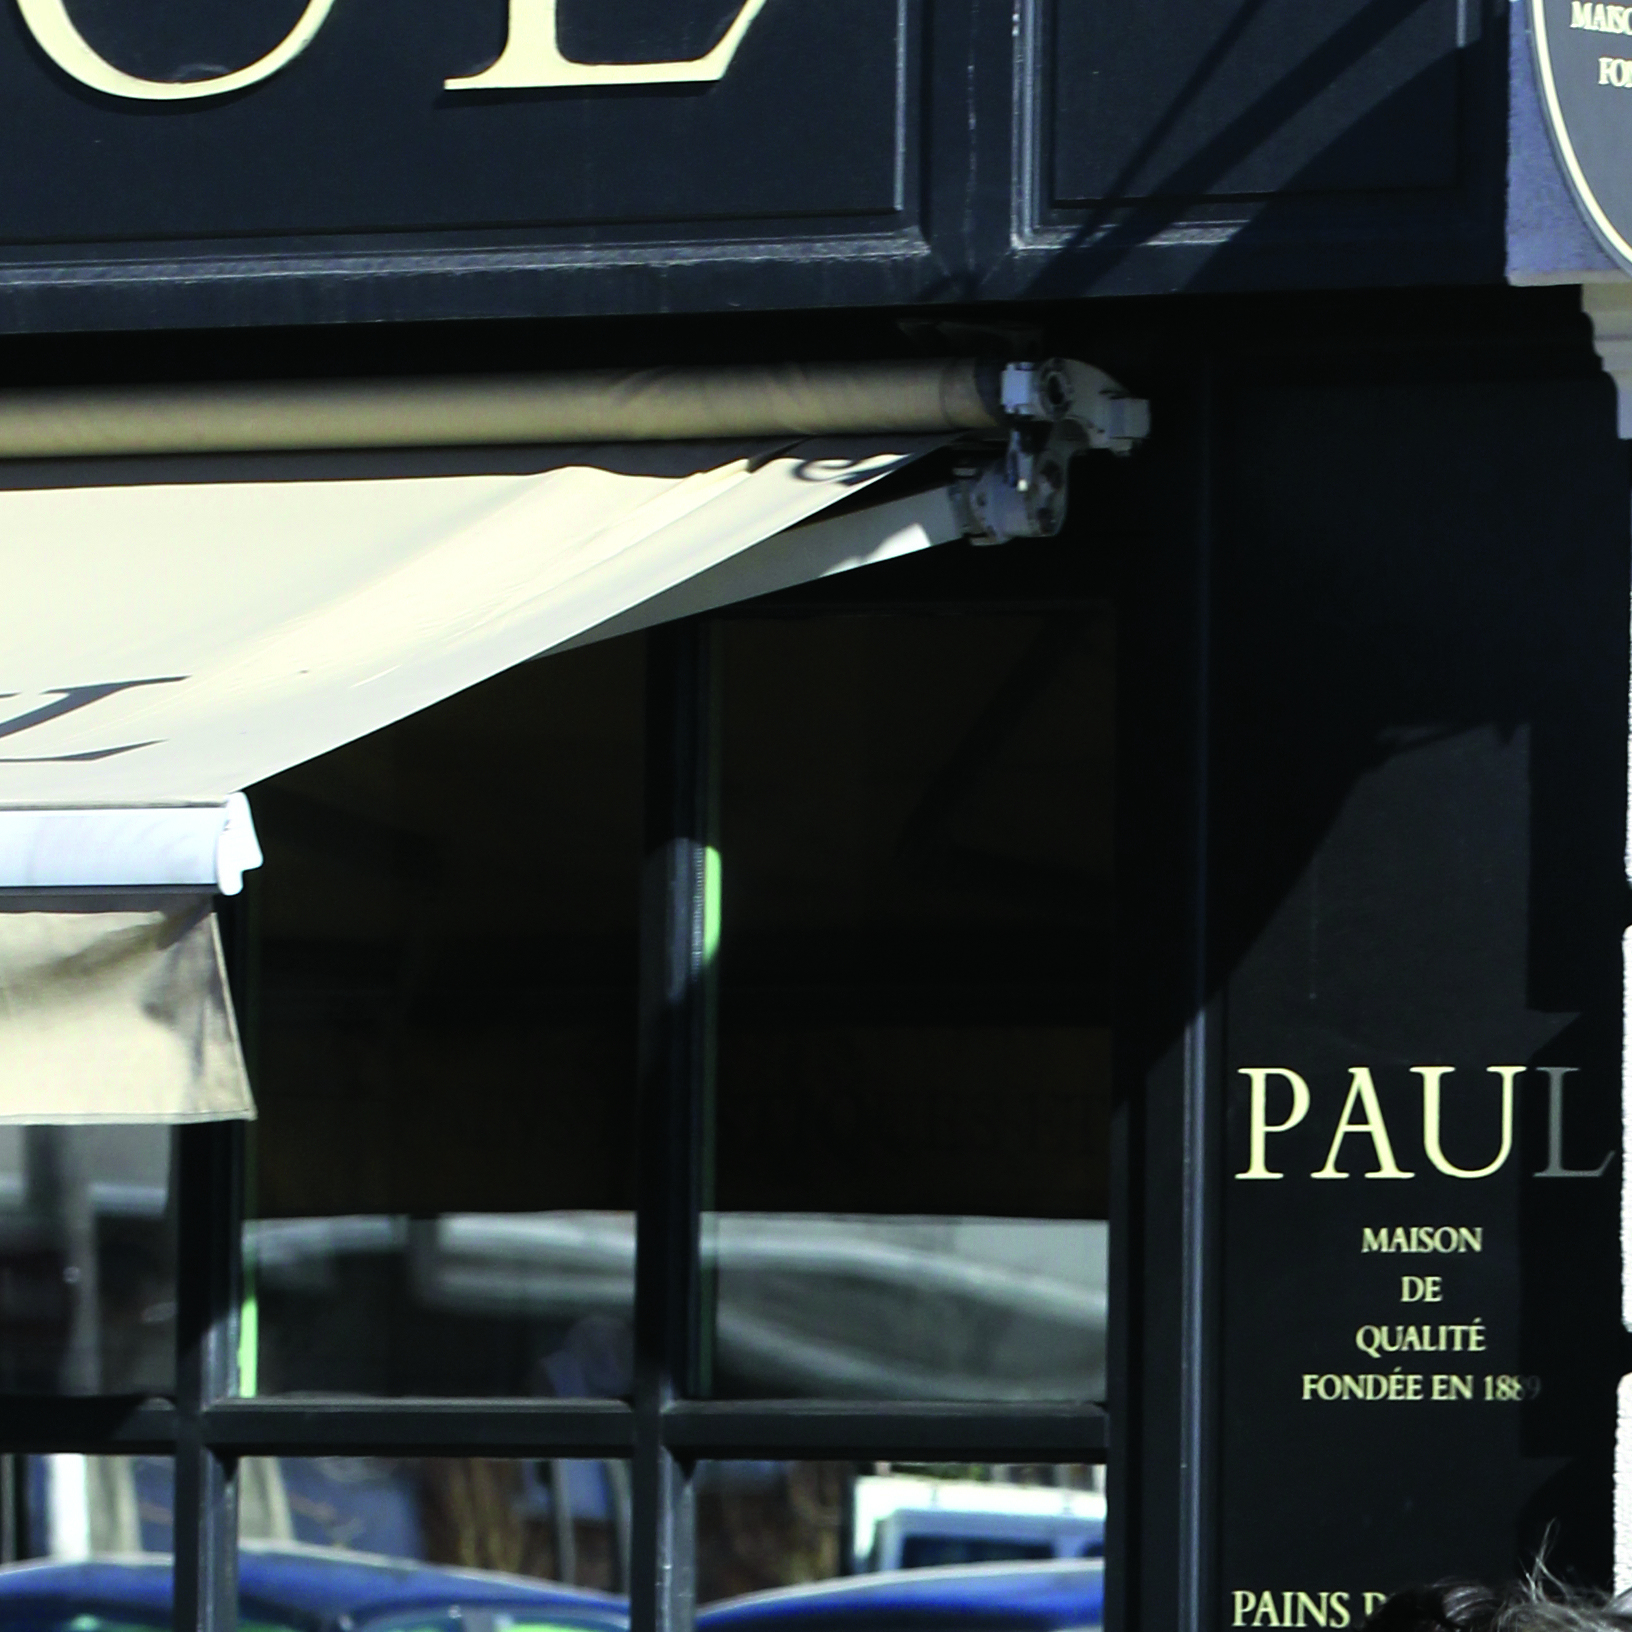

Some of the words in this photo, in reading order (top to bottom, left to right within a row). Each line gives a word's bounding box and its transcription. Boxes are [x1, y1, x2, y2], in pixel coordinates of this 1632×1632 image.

[1233, 1065, 1615, 1180] PAUL
[1361, 1226, 1483, 1254] MAISON
[1400, 1275, 1443, 1303] DE
[1355, 1317, 1487, 1359] QUALITÉ
[1301, 1366, 1424, 1401] FONDÉE
[1430, 1374, 1474, 1401] EN
[1232, 1590, 1351, 1629] PAINS
